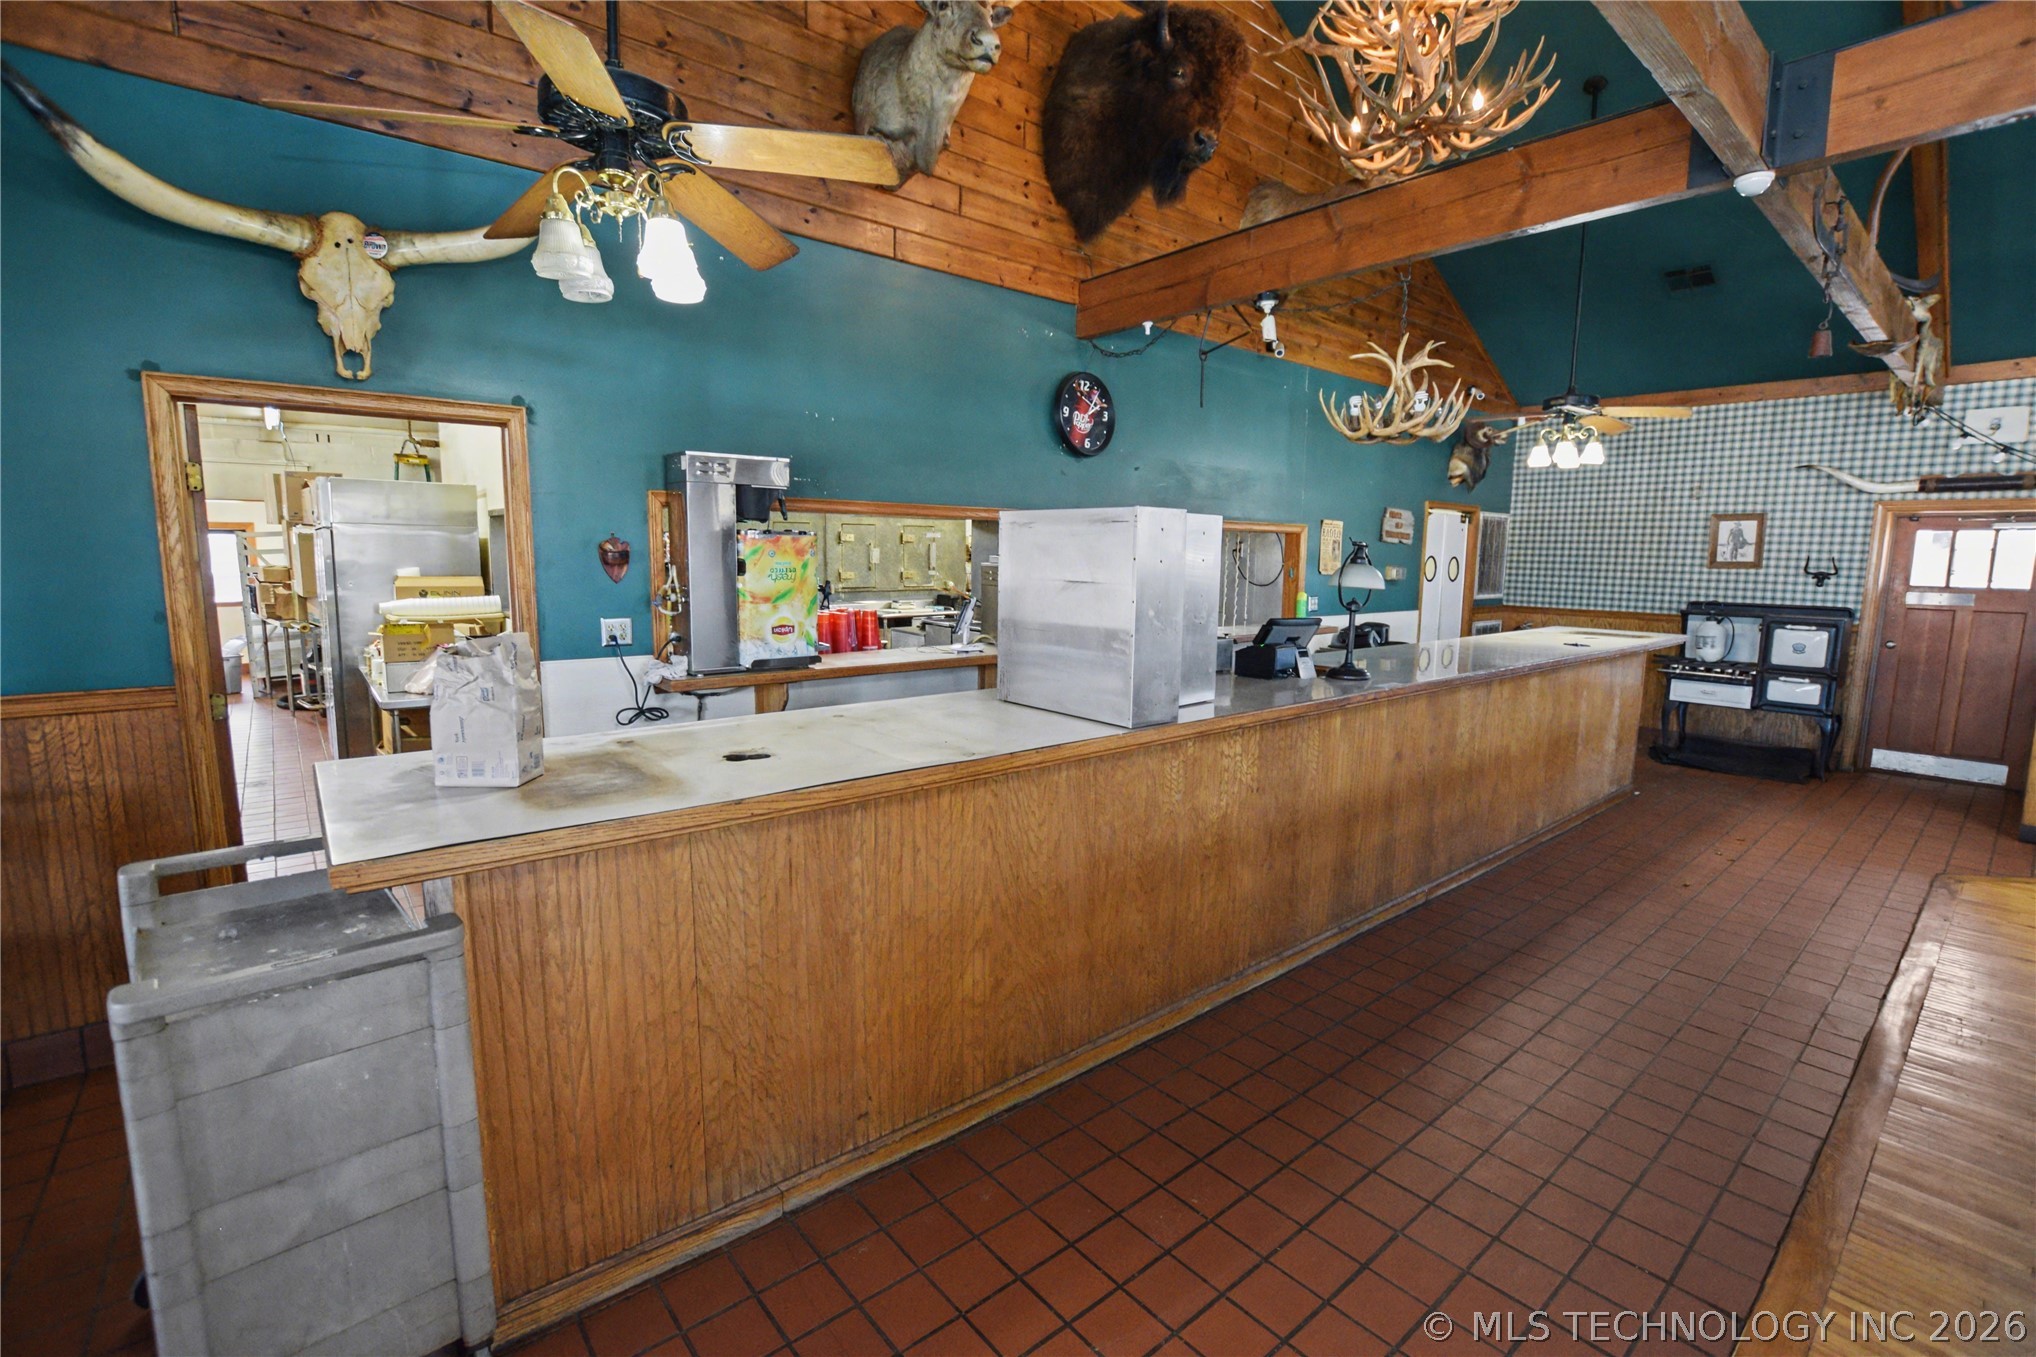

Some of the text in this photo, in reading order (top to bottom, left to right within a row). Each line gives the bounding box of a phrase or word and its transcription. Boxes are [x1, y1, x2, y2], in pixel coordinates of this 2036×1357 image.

[1079, 380, 1090, 391] 12
[1062, 406, 1069, 417] 9
[1102, 412, 1108, 422] 3
[1084, 438, 1091, 448] 6
